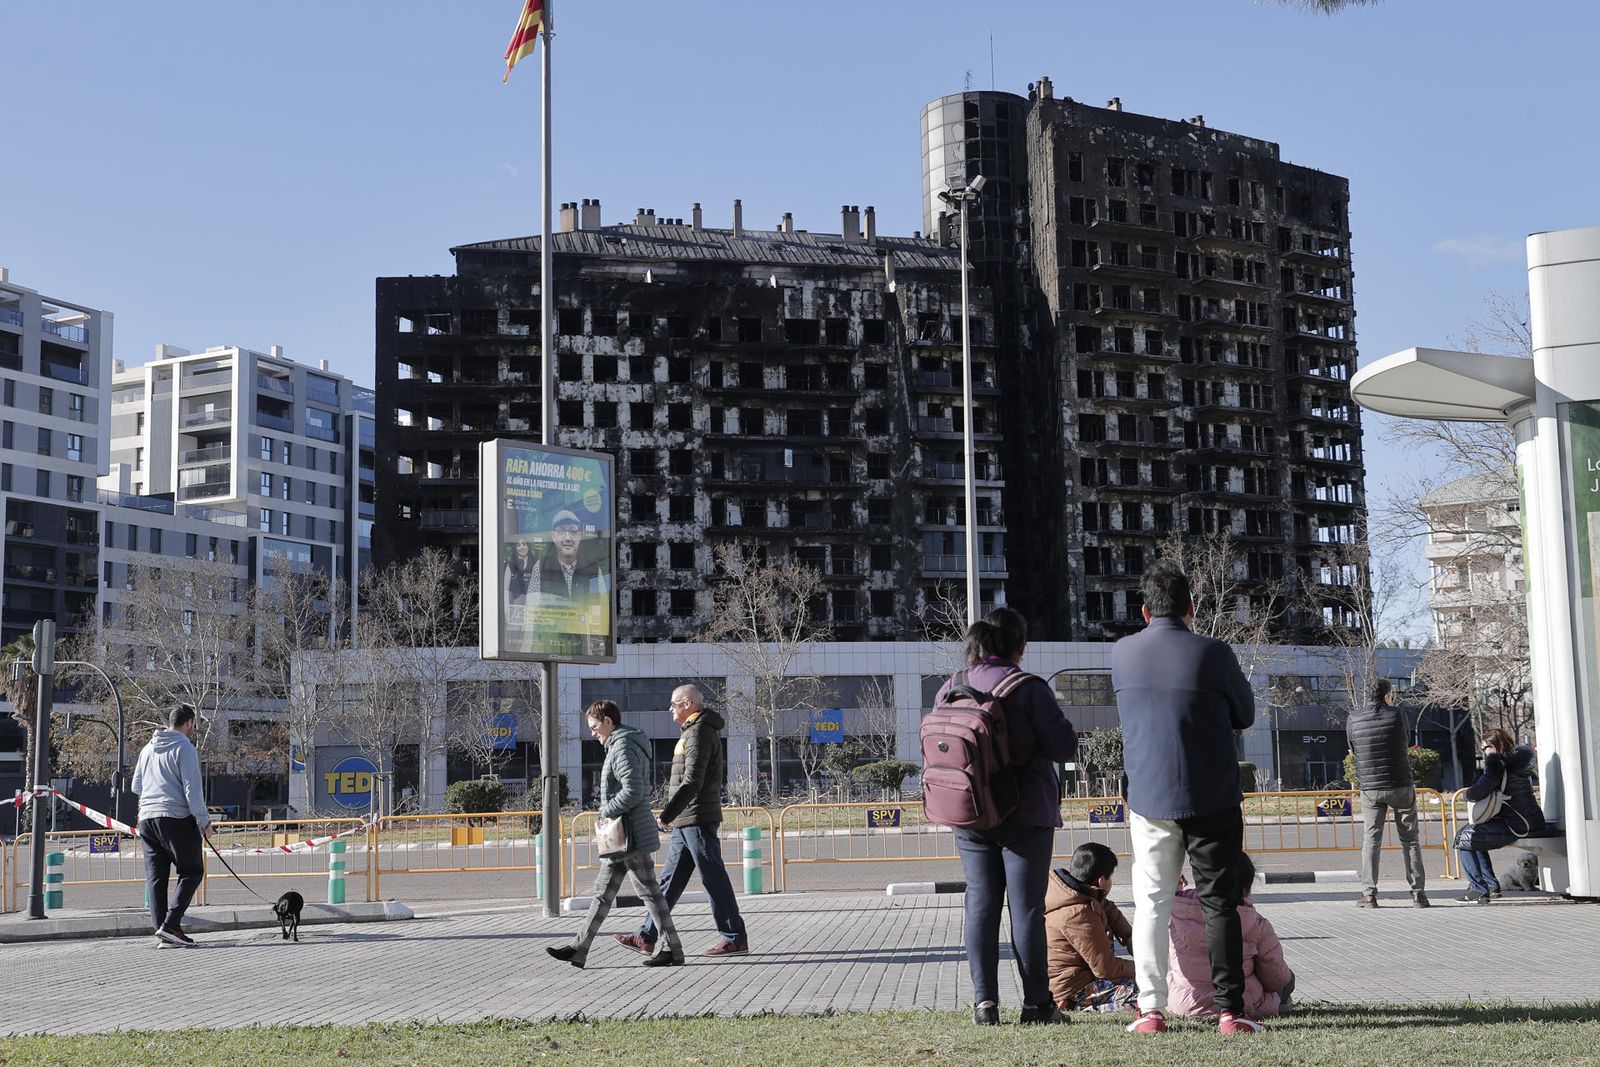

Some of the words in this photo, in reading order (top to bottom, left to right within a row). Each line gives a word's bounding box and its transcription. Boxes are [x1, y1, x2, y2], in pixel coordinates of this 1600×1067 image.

[506, 458, 528, 475] RAFA
[529, 461, 564, 478] AHORRA
[1303, 735, 1327, 743] BYD
[872, 810, 895, 820] SPV
[1095, 805, 1118, 816] SPV
[94, 837, 114, 846] SPV
